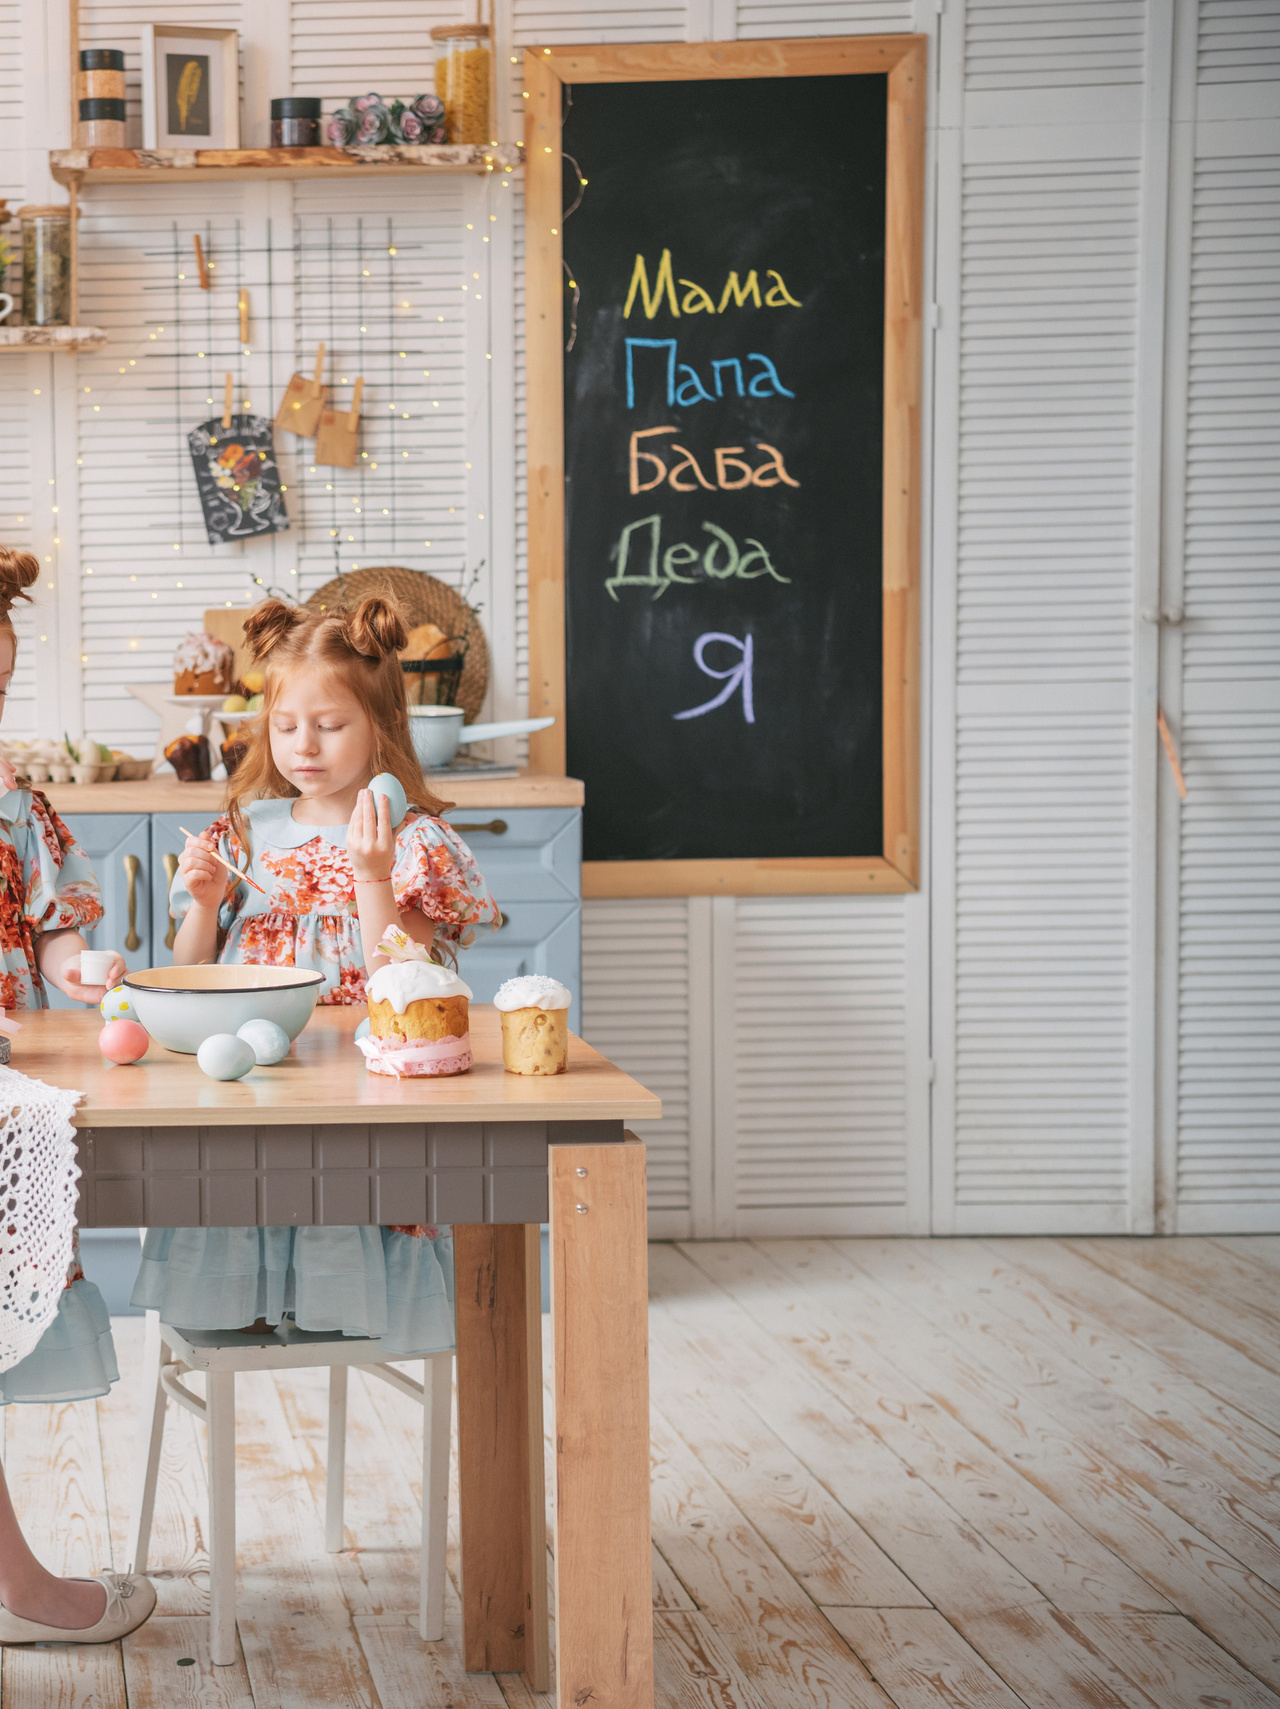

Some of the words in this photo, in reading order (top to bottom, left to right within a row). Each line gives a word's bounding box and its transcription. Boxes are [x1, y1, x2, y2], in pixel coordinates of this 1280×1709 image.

[623, 249, 802, 319] Мама
[624, 337, 795, 409] Папа
[629, 426, 800, 495] Баба
[605, 514, 791, 601] Деда
[673, 631, 755, 724] Я
